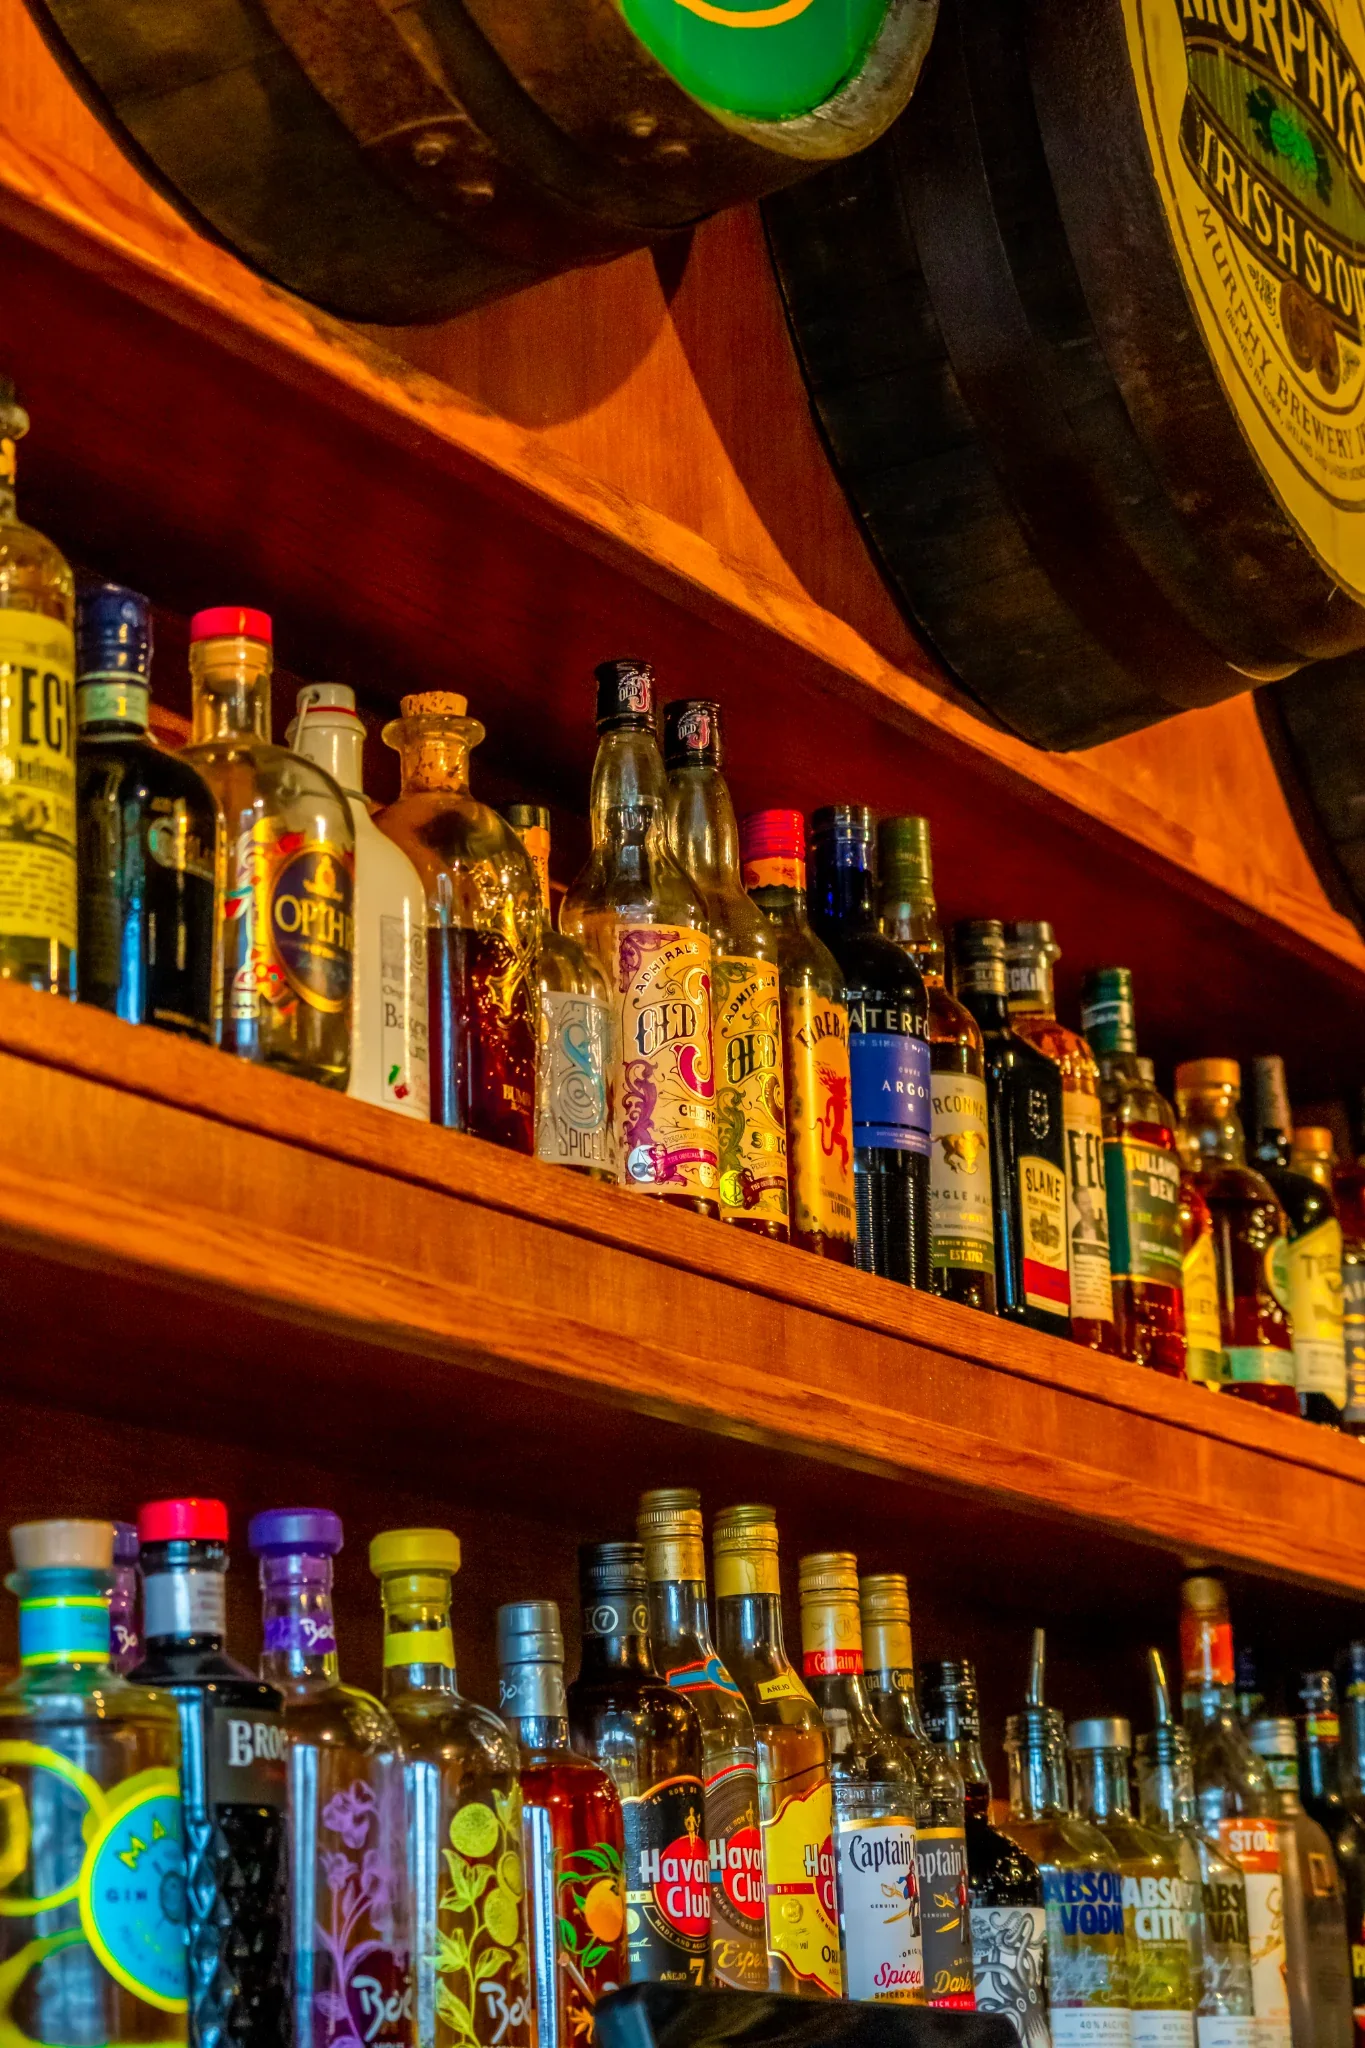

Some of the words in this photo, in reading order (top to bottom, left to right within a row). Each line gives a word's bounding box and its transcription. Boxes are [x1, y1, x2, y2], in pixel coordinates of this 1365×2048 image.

[1181, 0, 1365, 184] URPHY'S
[1200, 122, 1297, 275] IRISH
[1304, 229, 1365, 320] STOU
[1196, 205, 1272, 376] MURPHY
[1277, 374, 1354, 460] BREWERY
[635, 1003, 697, 1056] OLD
[795, 1011, 847, 1050] FIREBA
[848, 1008, 930, 1040] ATERFO
[723, 1034, 776, 1084] OLD
[678, 1104, 716, 1125] CHERR
[931, 1095, 987, 1122] RCONNE
[751, 1131, 787, 1156] SPIC
[930, 1190, 968, 1201] NGLE
[1026, 1168, 1061, 1202] SLANE
[598, 1611, 610, 1628] 7
[638, 1611, 646, 1628] 7
[766, 1683, 790, 1693] AÑEJO
[669, 1786, 684, 1796] RON
[639, 1848, 710, 1884] Havan
[708, 1838, 763, 1870] Hava
[803, 1842, 837, 1878] Hav
[848, 1832, 911, 1873] Captain
[917, 1844, 962, 1884] aptain
[667, 1886, 710, 1918] Club
[655, 1919, 673, 1939] MADE
[675, 1937, 690, 1948] AND
[1060, 1904, 1125, 1935] VODK
[1134, 1908, 1184, 1941] CITR
[660, 1970, 687, 1981] AÑEJO
[689, 1958, 704, 1987] 7
[873, 1962, 922, 1988] Spiced
[932, 1970, 972, 1993] Dark
[874, 1991, 905, 1999] SPICED
